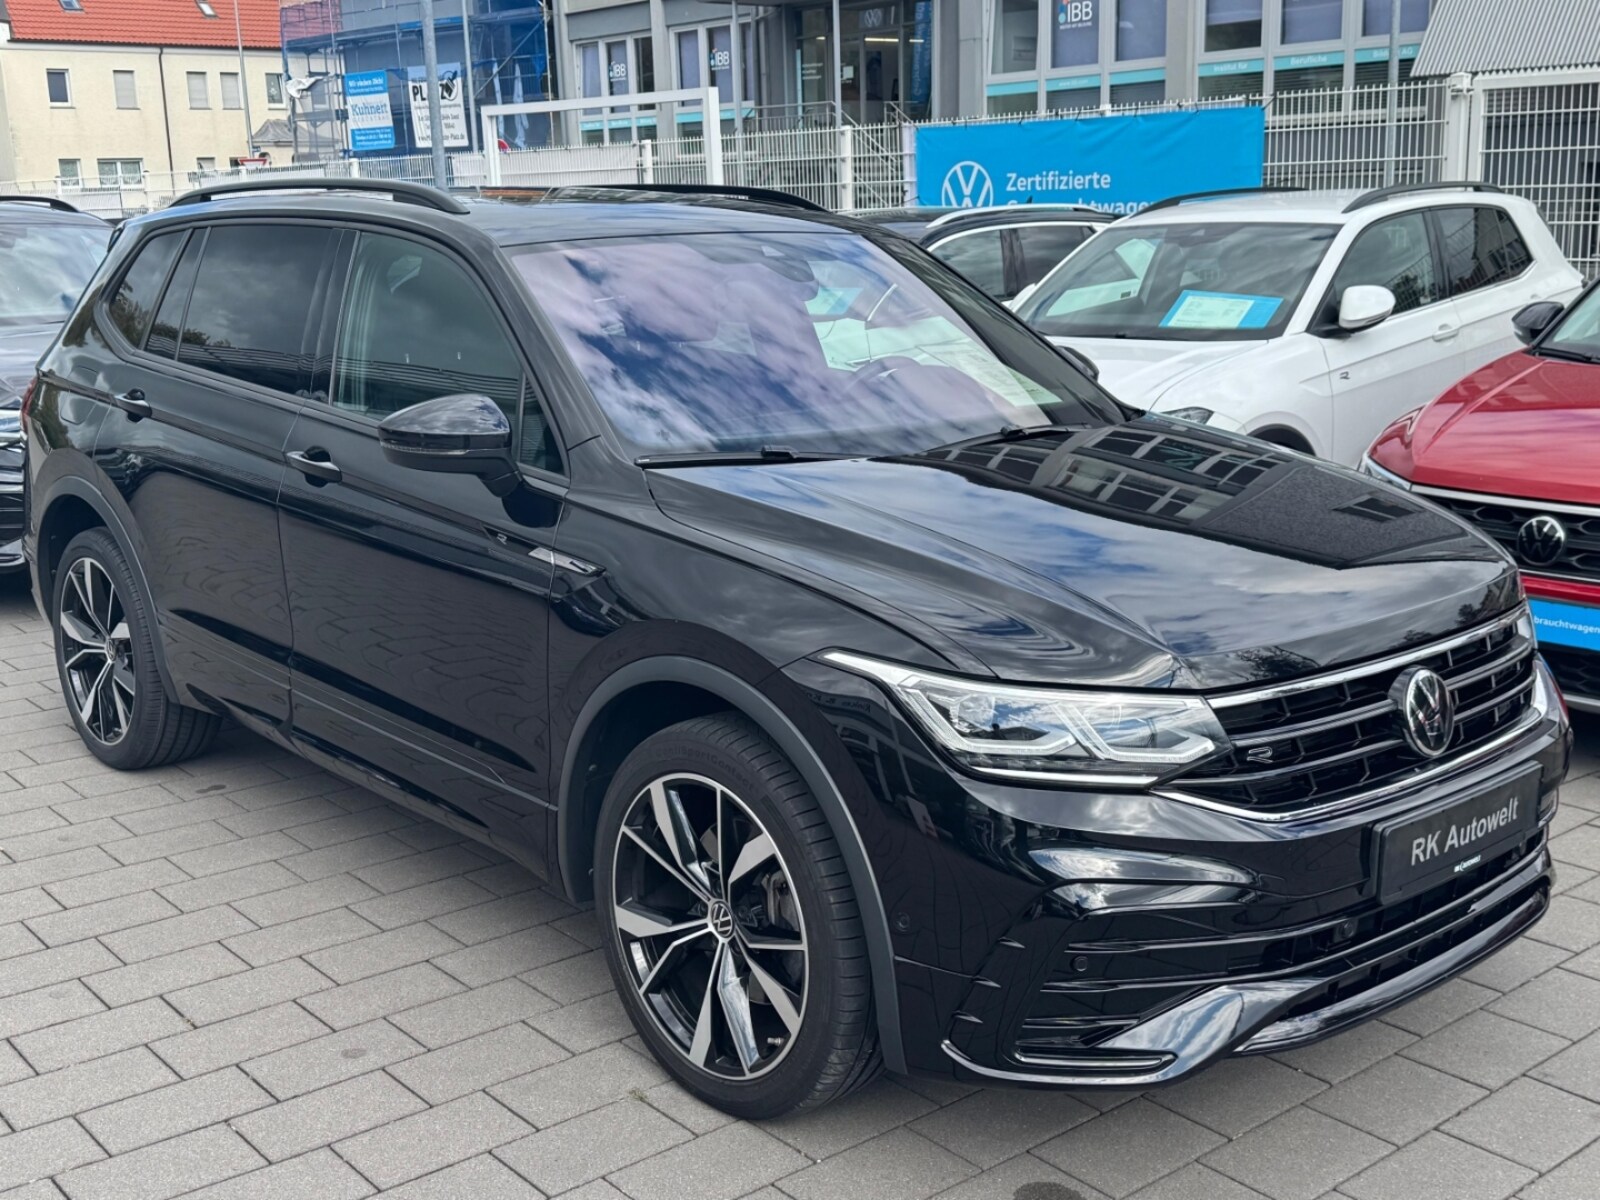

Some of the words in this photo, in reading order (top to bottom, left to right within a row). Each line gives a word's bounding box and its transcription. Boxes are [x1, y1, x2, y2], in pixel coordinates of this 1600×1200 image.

[1067, 0, 1093, 23] IBB
[1401, 45, 1414, 56] AG
[715, 51, 730, 66] IBB
[1290, 55, 1328, 66] Berufliche
[613, 63, 627, 77] IBB
[351, 103, 389, 116] Kuhnert
[1006, 170, 1112, 192] Zertifizierte
[1410, 829, 1442, 867] RK
[1443, 796, 1519, 854] Autowelt
